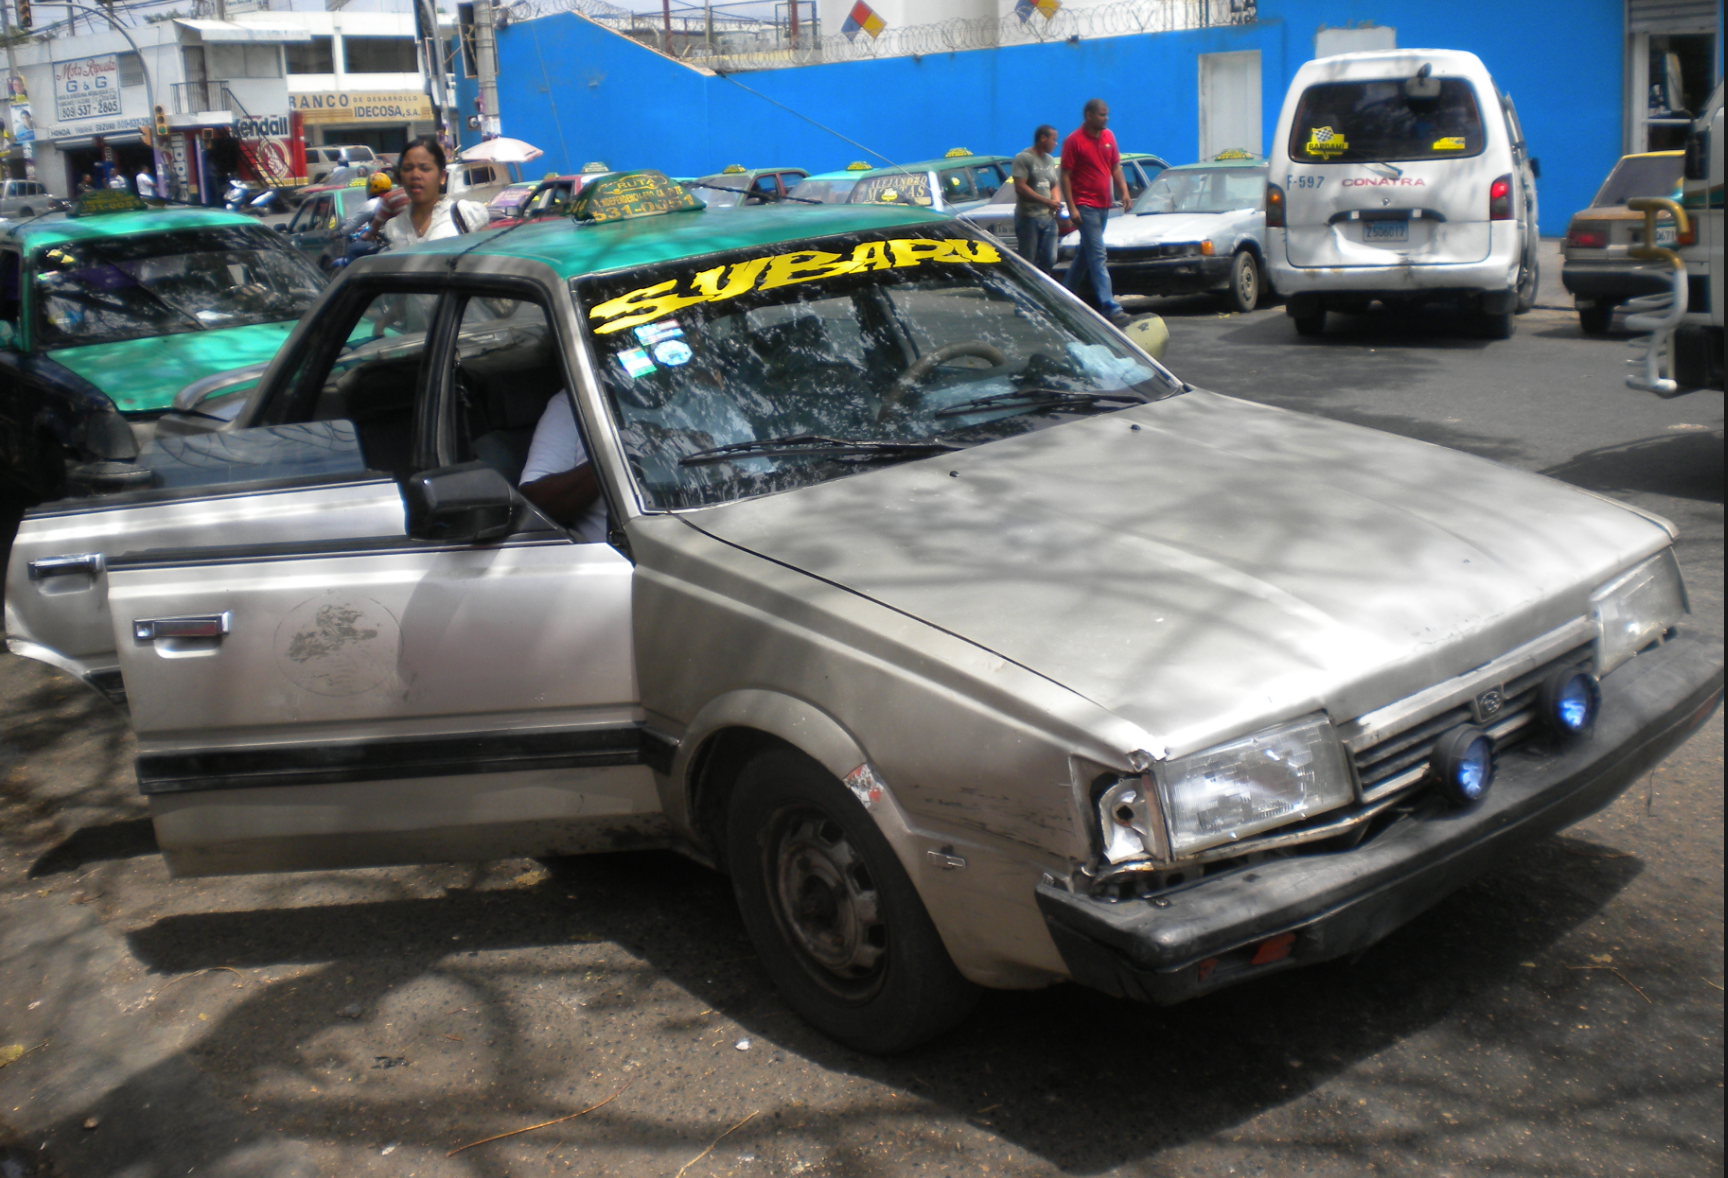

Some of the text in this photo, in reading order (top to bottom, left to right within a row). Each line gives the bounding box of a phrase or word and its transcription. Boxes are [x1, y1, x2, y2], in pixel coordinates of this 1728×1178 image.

[66, 80, 78, 92] G
[95, 76, 107, 88] G
[288, 94, 349, 109] BANCO
[366, 95, 418, 103] DESARROLLO
[96, 122, 116, 131] SUZUKI
[617, 178, 655, 189] RUTA
[870, 175, 928, 189] ALEJANDRO
[1286, 175, 1325, 191] F-597
[1341, 178, 1426, 187] CONATRA
[867, 184, 926, 202] MTAS
[589, 238, 1001, 334] SUBARU
